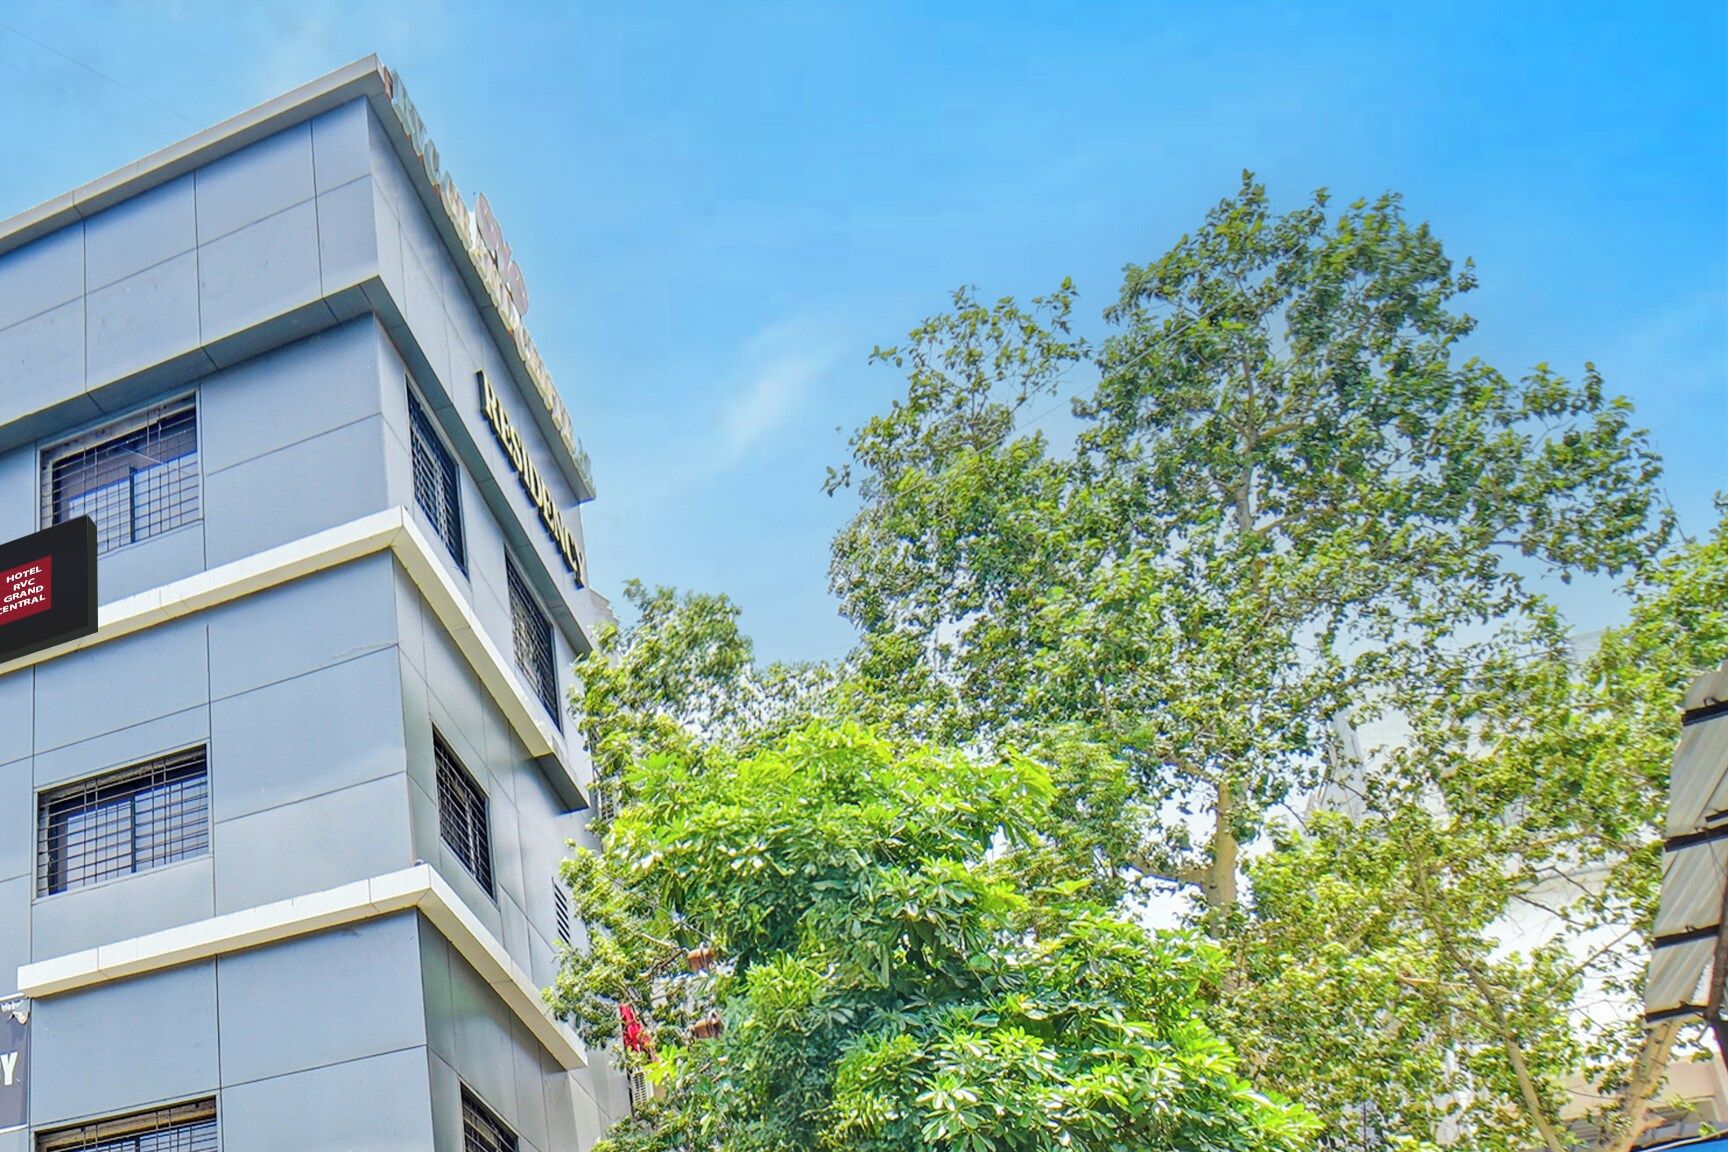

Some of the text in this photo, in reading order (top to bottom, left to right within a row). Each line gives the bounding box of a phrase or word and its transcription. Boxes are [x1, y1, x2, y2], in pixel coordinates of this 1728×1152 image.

[476, 369, 585, 589] RESIDENCY
[6, 565, 43, 583] HOTEL
[13, 577, 35, 591] RVC
[3, 585, 44, 602] GRAND
